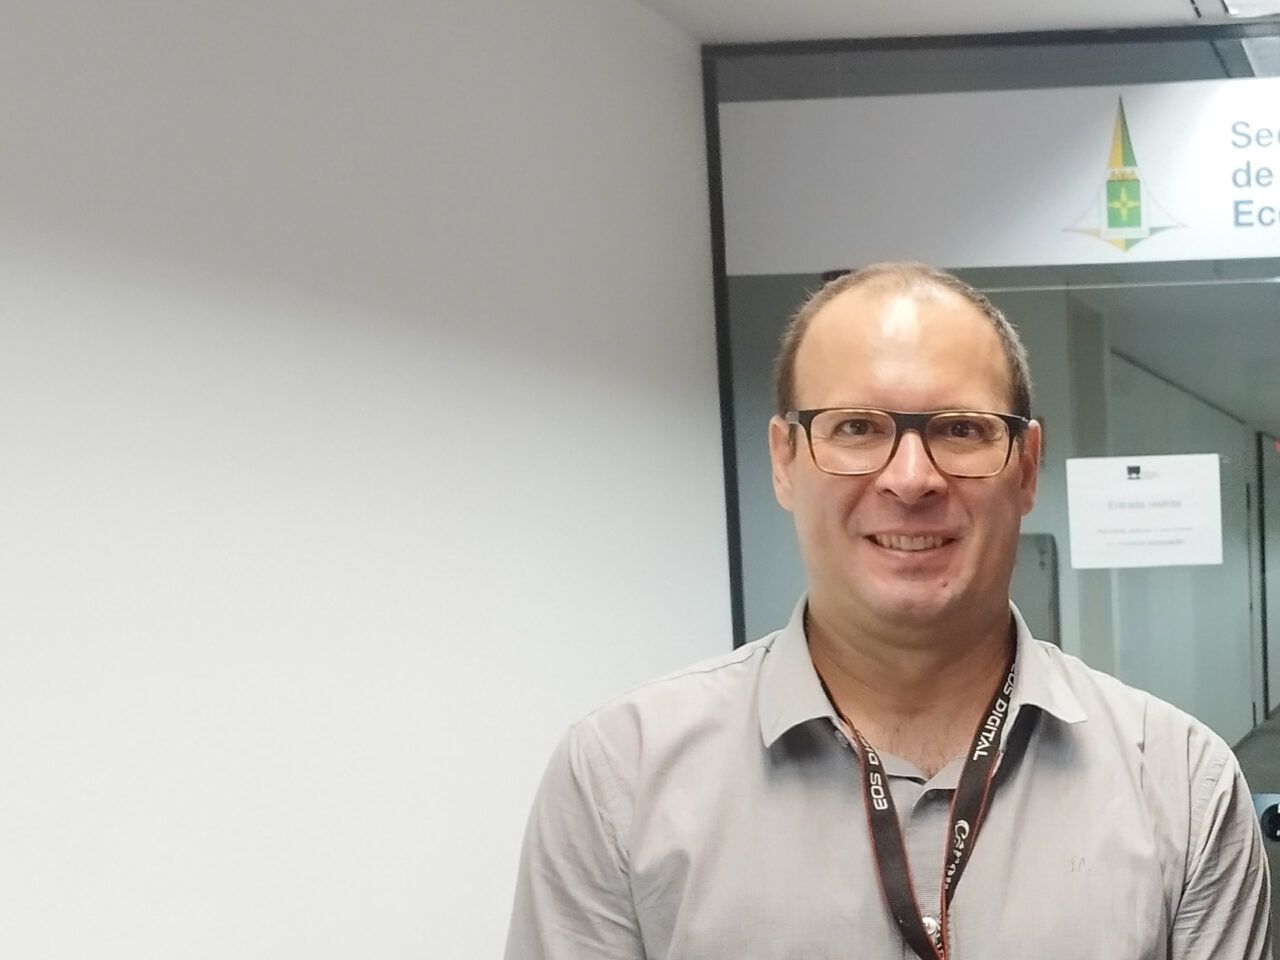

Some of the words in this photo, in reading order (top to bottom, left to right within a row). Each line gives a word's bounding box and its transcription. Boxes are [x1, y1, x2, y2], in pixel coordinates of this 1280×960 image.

[1231, 159, 1275, 189] de
[972, 697, 1008, 761] DIGITAL
[869, 772, 888, 810] EOS
